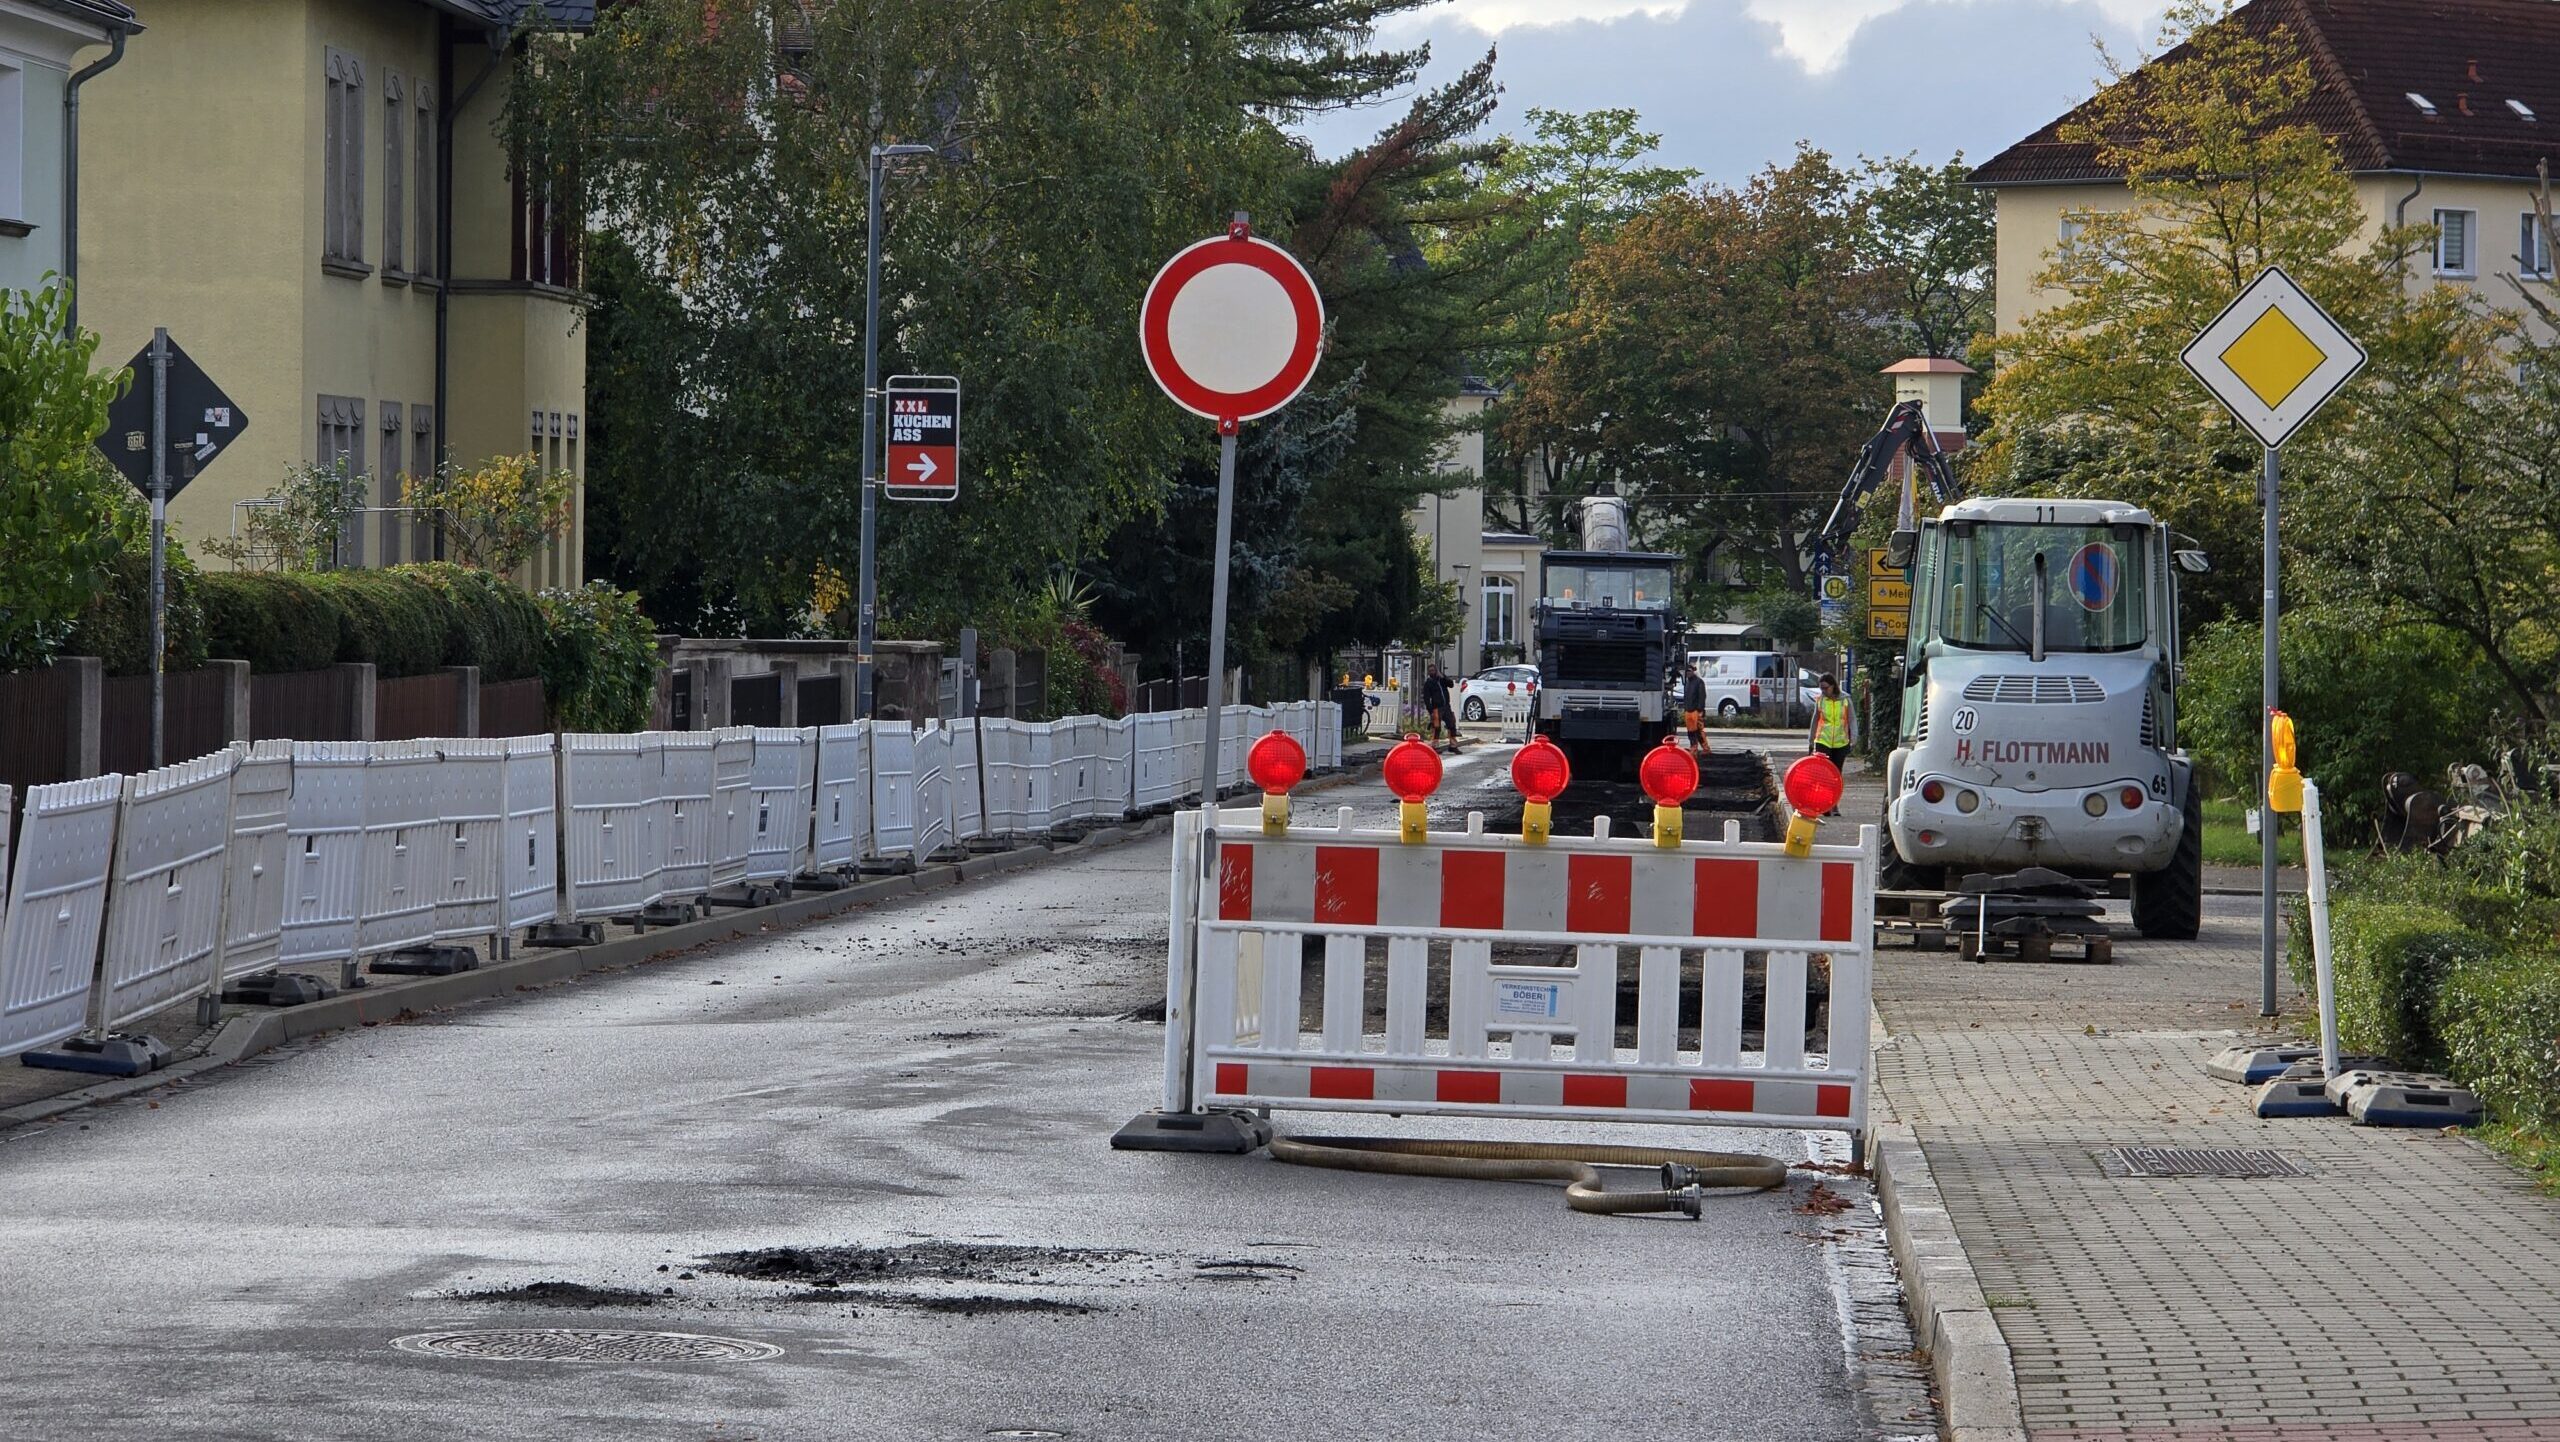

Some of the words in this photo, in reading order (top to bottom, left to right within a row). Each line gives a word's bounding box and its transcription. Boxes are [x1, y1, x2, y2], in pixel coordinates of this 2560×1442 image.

[895, 400, 927, 413] XXL
[893, 414, 951, 429] KÜCHEN
[893, 429, 922, 442] ASS
[1930, 481, 1943, 504] ATLAS
[1830, 582, 1840, 594] H
[1955, 710, 1975, 731] 20
[1956, 738, 1975, 761] H.
[1982, 740, 2109, 764] FLOTTMANN
[1902, 769, 1916, 791] 65
[2152, 774, 2167, 796] 65
